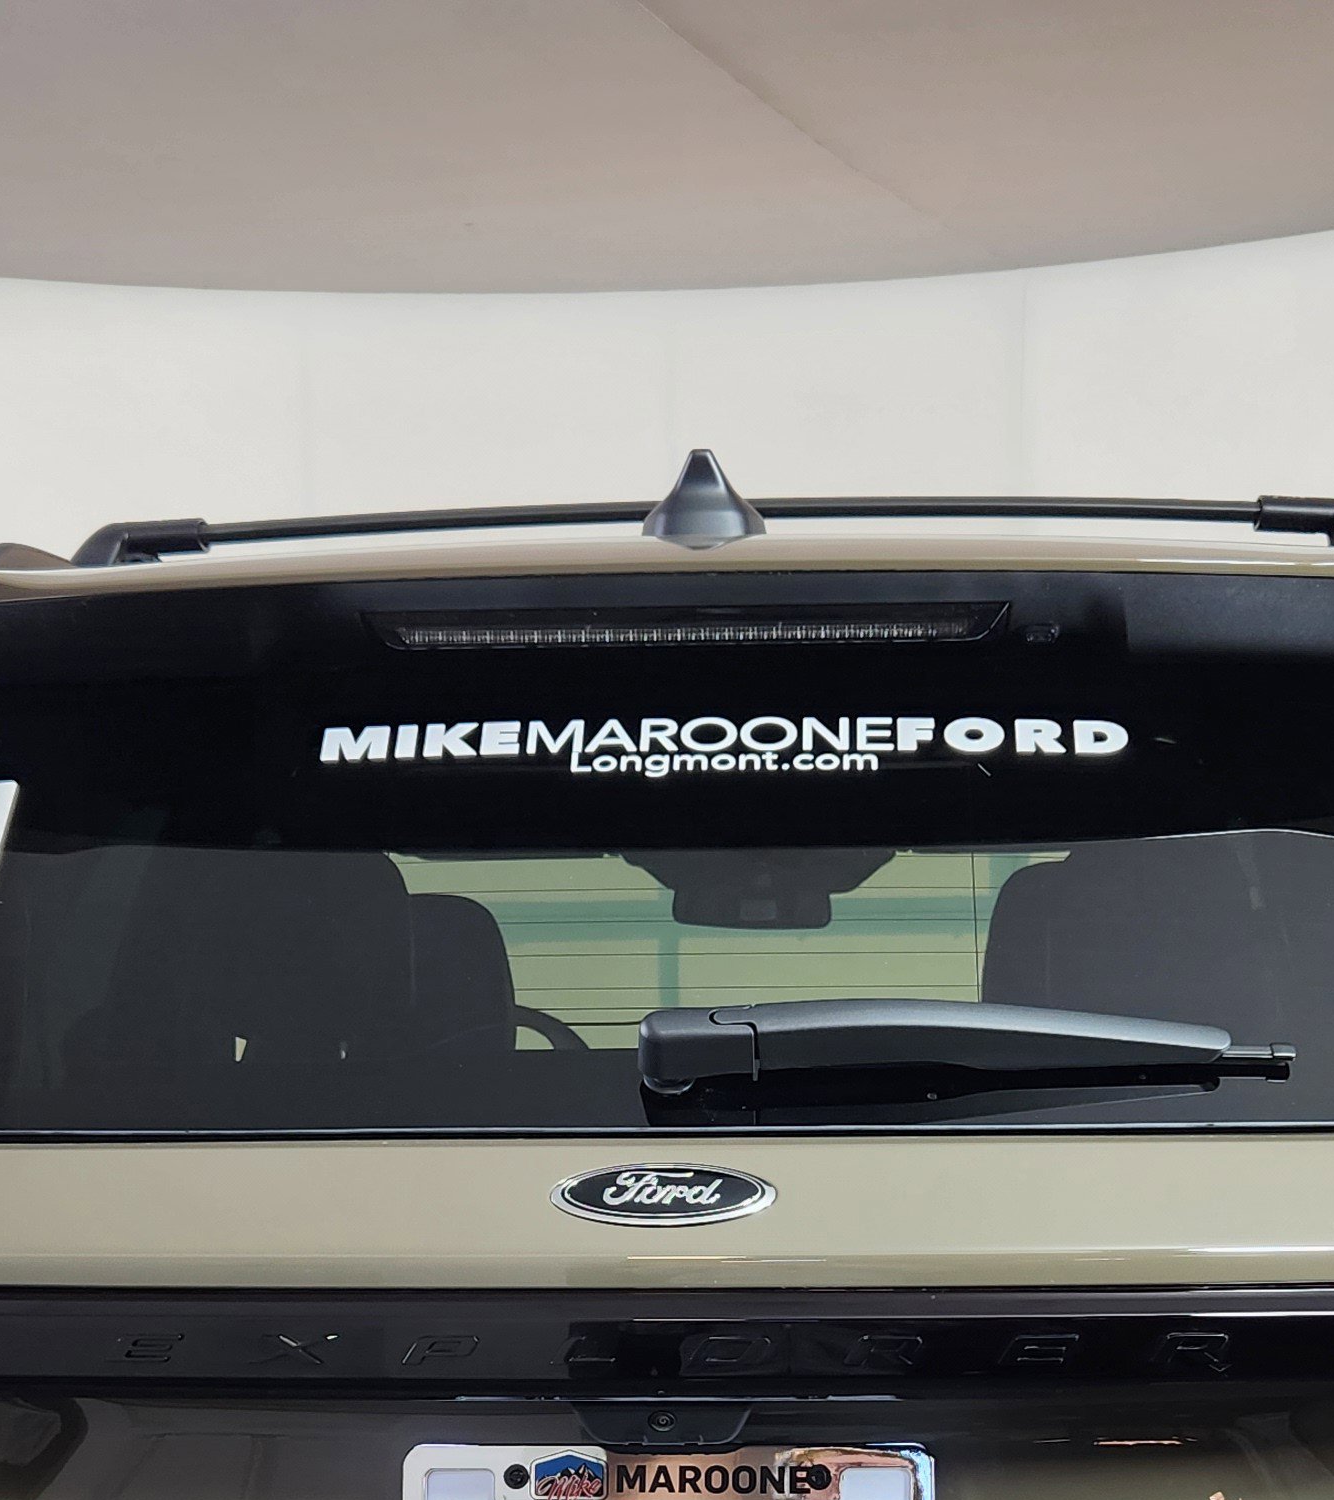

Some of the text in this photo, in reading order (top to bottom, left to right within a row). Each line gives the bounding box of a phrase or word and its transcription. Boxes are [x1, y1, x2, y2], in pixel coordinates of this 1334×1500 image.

[569, 749, 879, 778] Longmont.com
[602, 1170, 721, 1206] Ford
[105, 1328, 1233, 1367] EXPLORER
[615, 1464, 812, 1495] MAROONE
